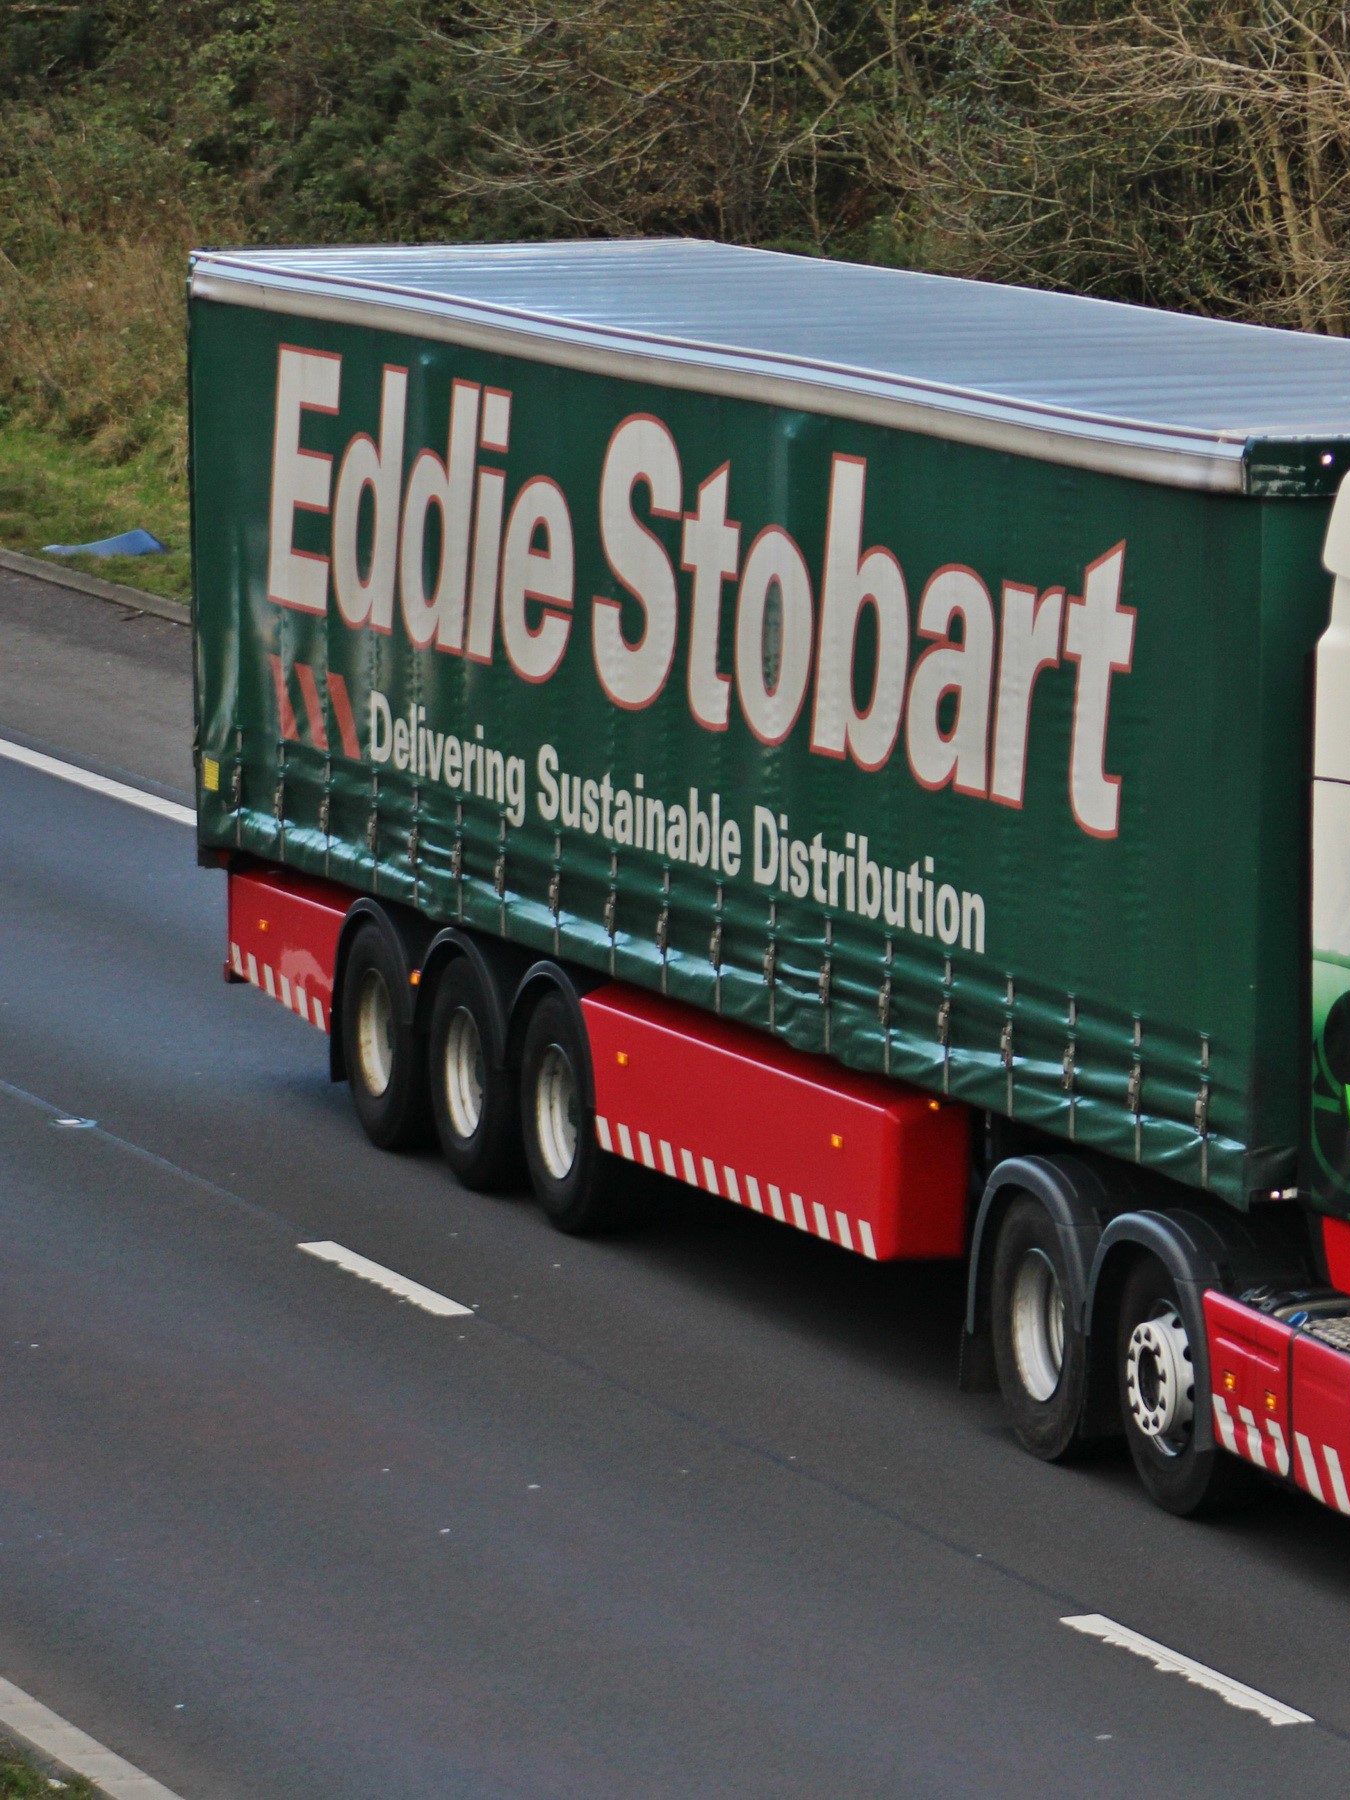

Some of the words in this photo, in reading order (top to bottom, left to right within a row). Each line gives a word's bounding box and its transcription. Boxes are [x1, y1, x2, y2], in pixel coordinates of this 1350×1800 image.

[268, 343, 575, 683] Eddie
[592, 412, 1137, 840] Stobart
[370, 690, 526, 827] Delivering
[537, 743, 742, 877] Sustainable
[753, 804, 986, 954] Distribution
